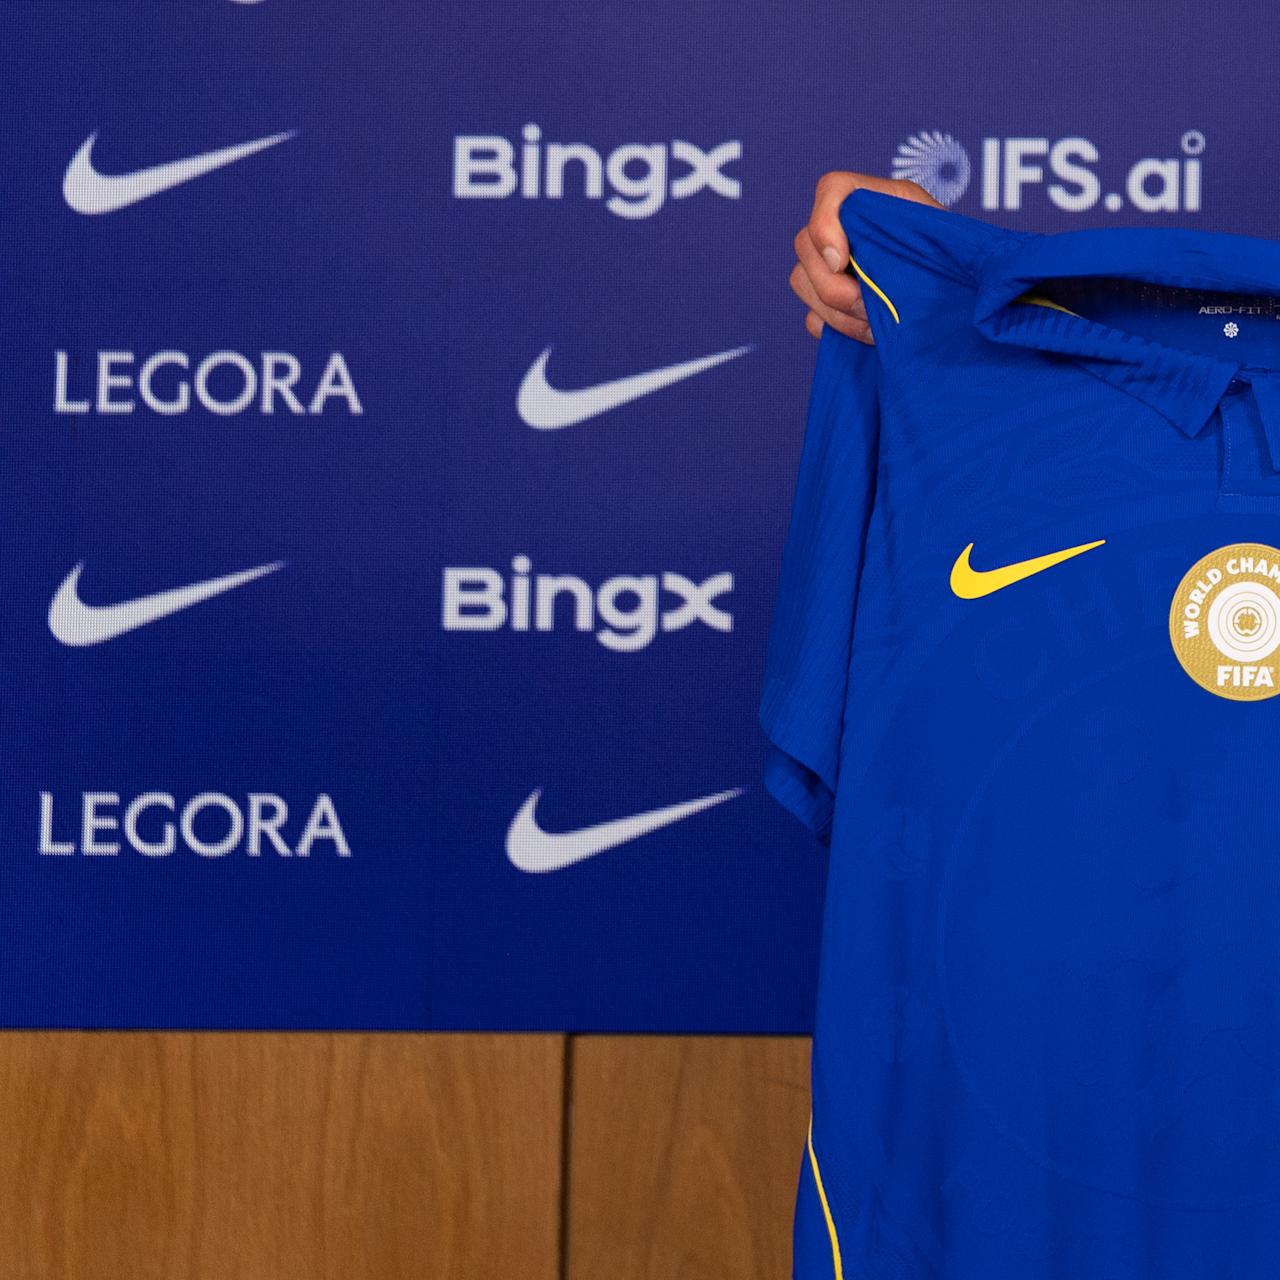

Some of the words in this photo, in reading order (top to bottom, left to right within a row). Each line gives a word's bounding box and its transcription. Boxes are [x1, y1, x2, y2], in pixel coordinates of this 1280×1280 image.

[981, 131, 1205, 213] IFS.ai
[53, 349, 364, 416] LEGORA
[1184, 568, 1222, 639] WORLD
[1216, 665, 1274, 687] FIFA
[38, 791, 352, 858] LEGORA
